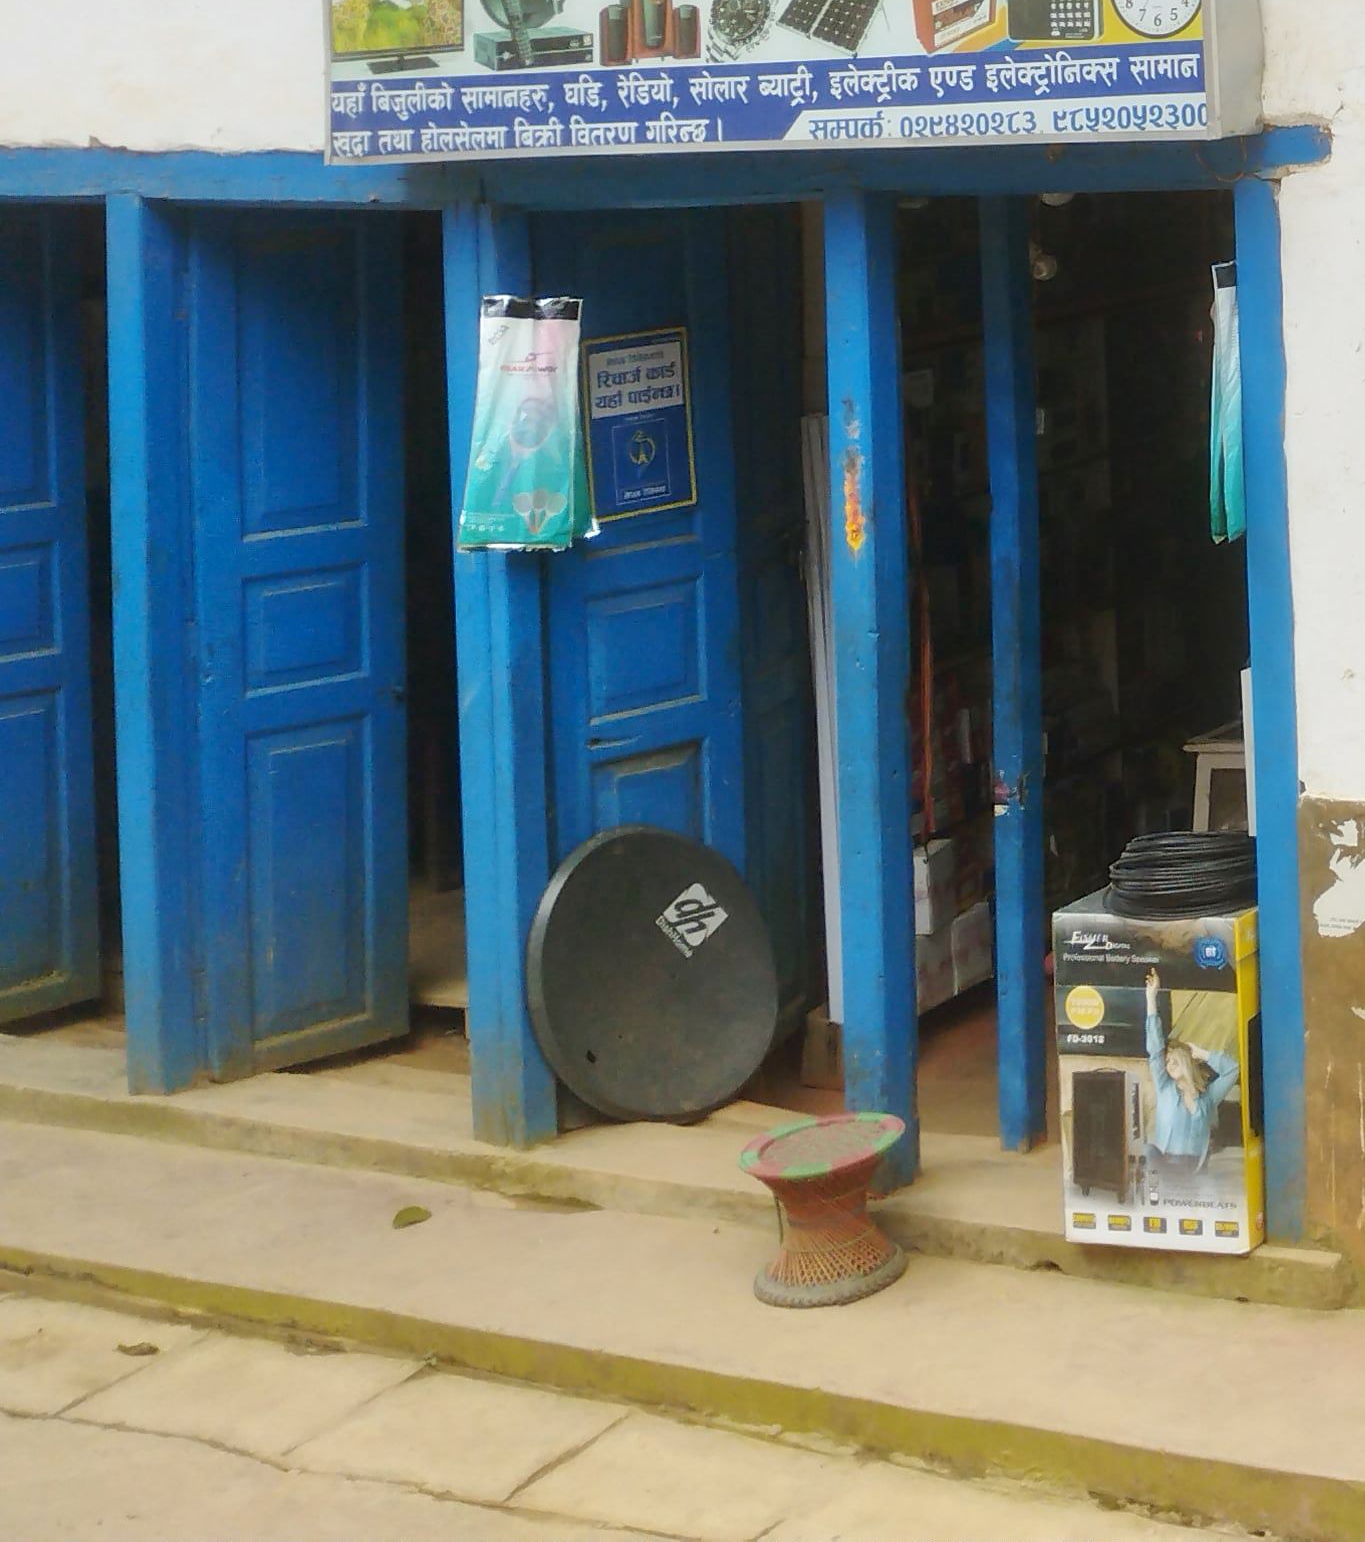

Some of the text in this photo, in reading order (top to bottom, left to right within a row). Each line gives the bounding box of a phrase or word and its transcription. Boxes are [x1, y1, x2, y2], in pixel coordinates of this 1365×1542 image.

[331, 50, 1201, 121] यहाँ बिजुलीको सामानहरु, घडि, रेडियो, सोलार ब्याट्री, इलेक्ट्रीक एण्ड इलेक्ट्रोनिक्स सामान
[378, 128, 415, 155] तथा
[420, 120, 506, 153] होलसेलमा
[514, 114, 564, 148] बिक्री
[569, 113, 638, 146] वितरण
[645, 110, 711, 143] गरिन्छ
